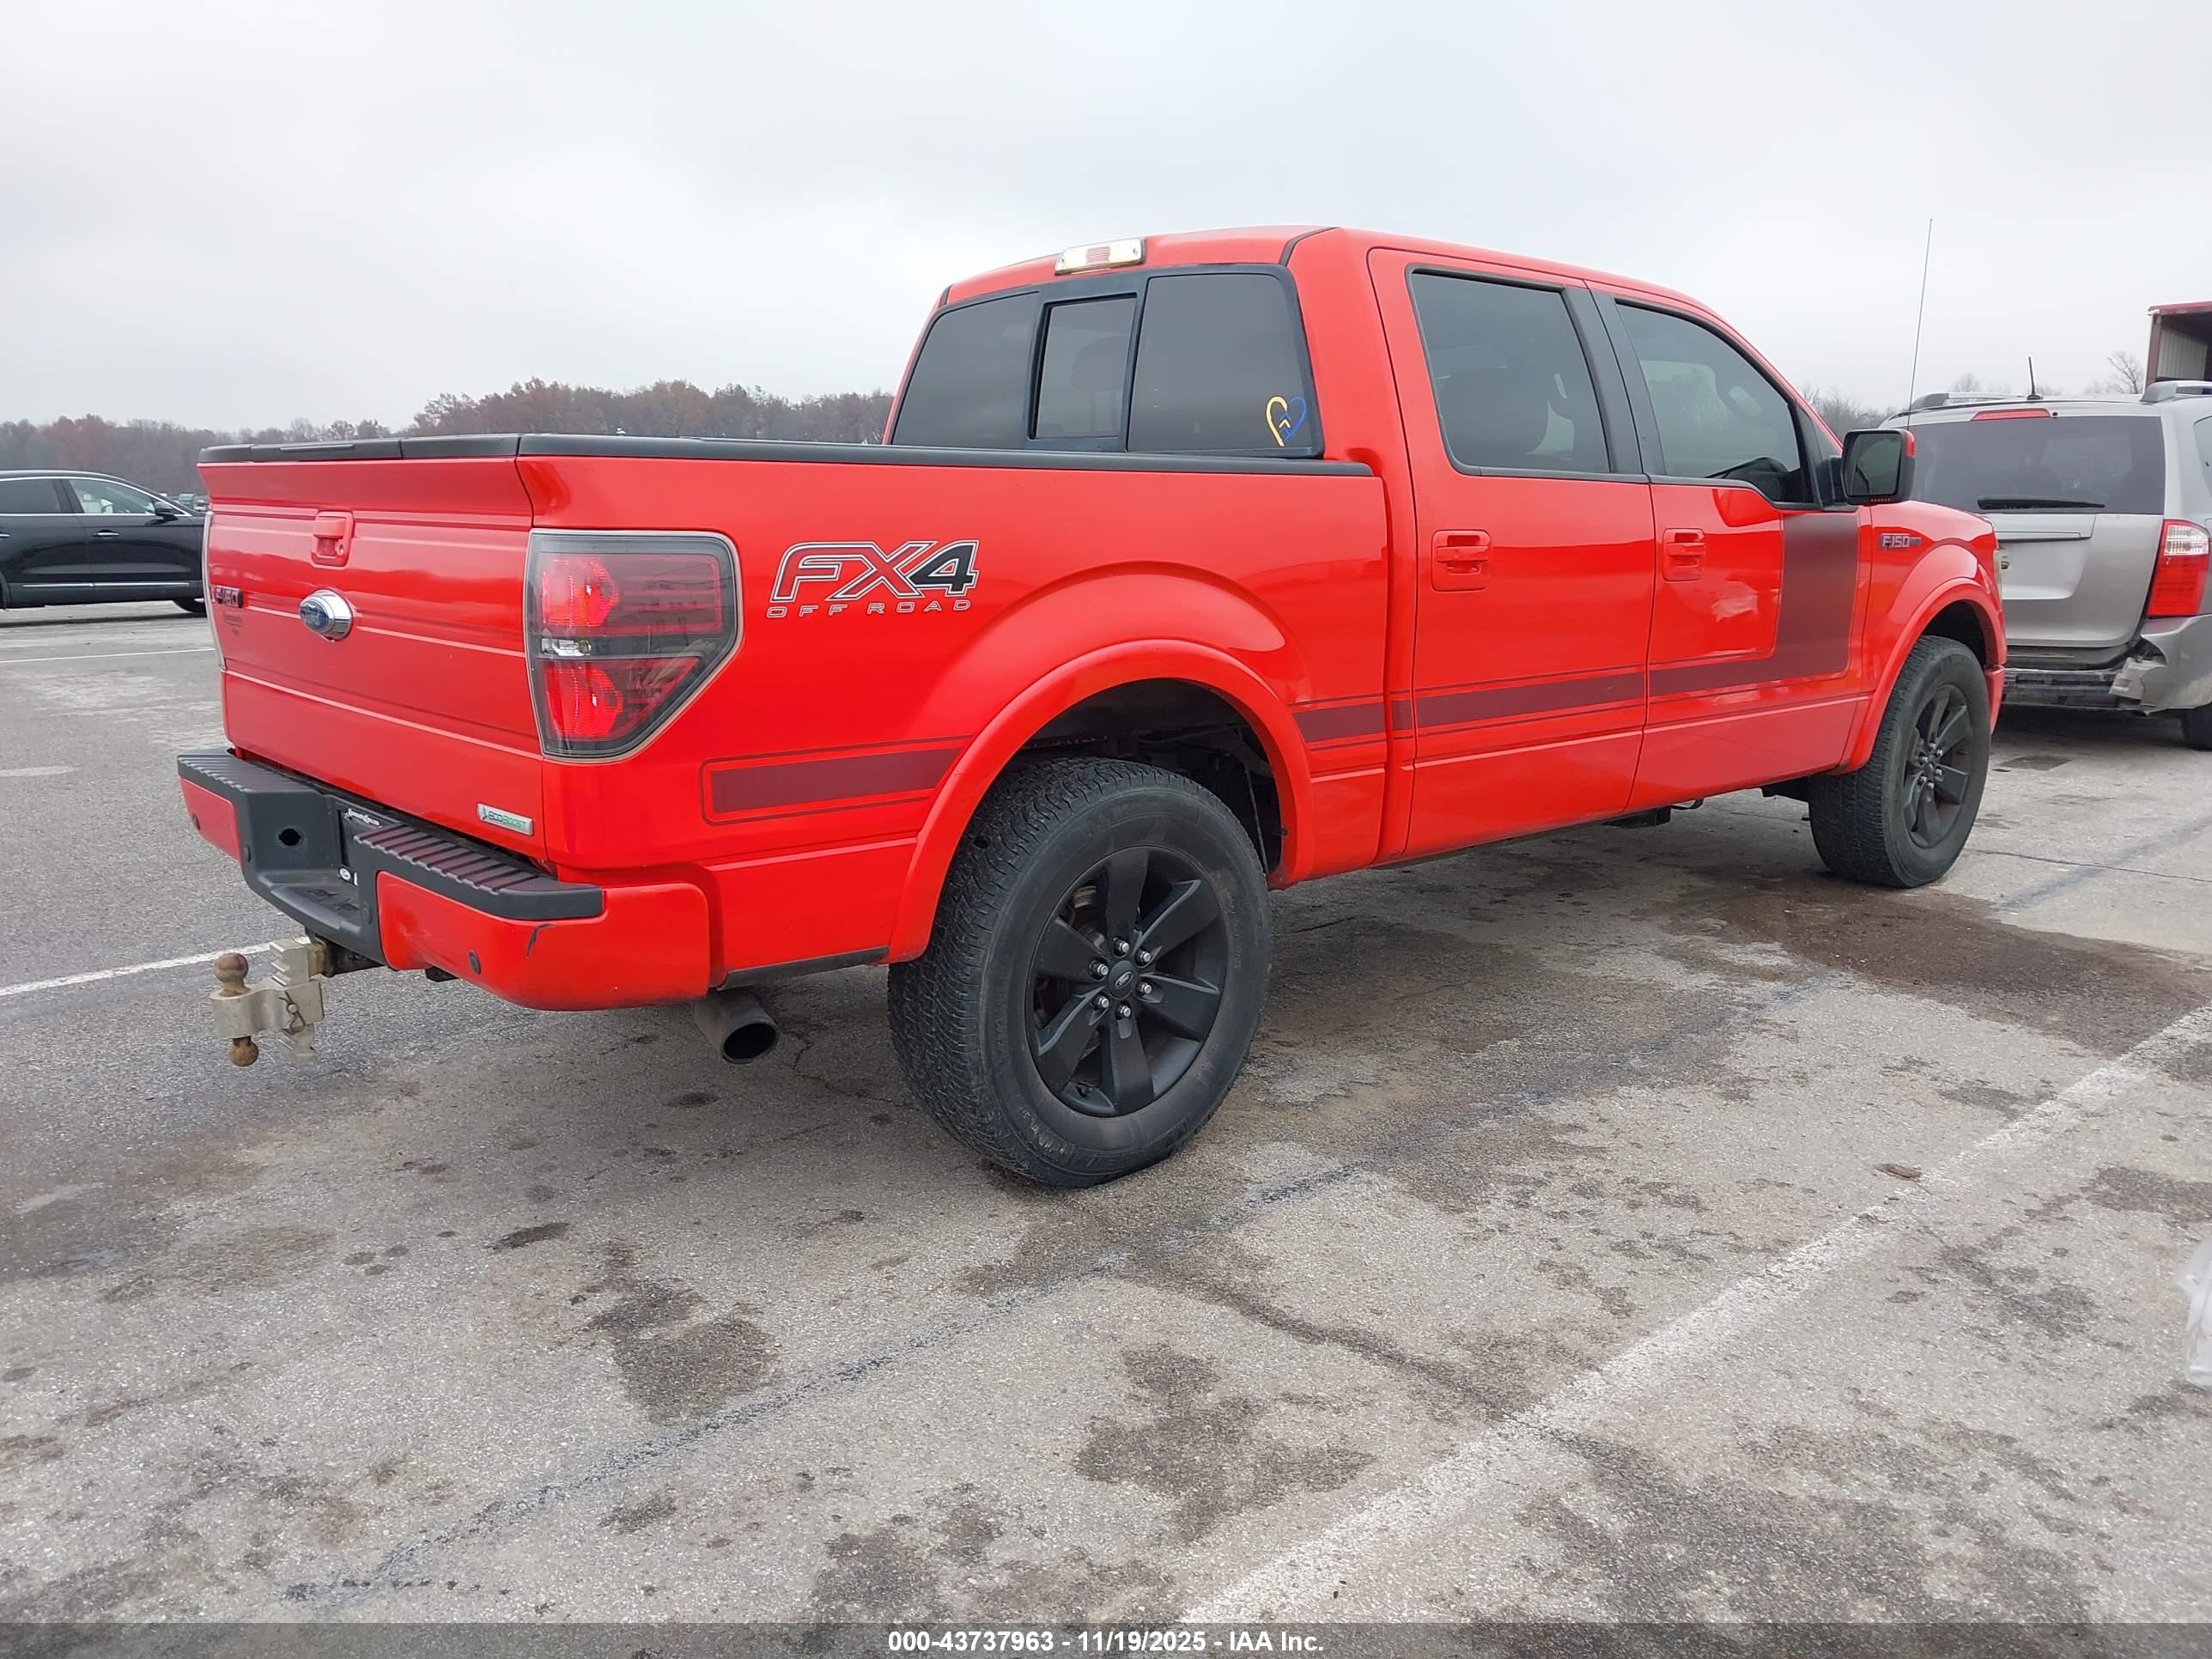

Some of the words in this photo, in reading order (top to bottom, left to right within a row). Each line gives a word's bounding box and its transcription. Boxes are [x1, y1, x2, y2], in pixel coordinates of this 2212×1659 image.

[769, 540, 980, 603] FX4
[766, 605, 848, 619] OFF
[866, 599, 971, 615] ROAD
